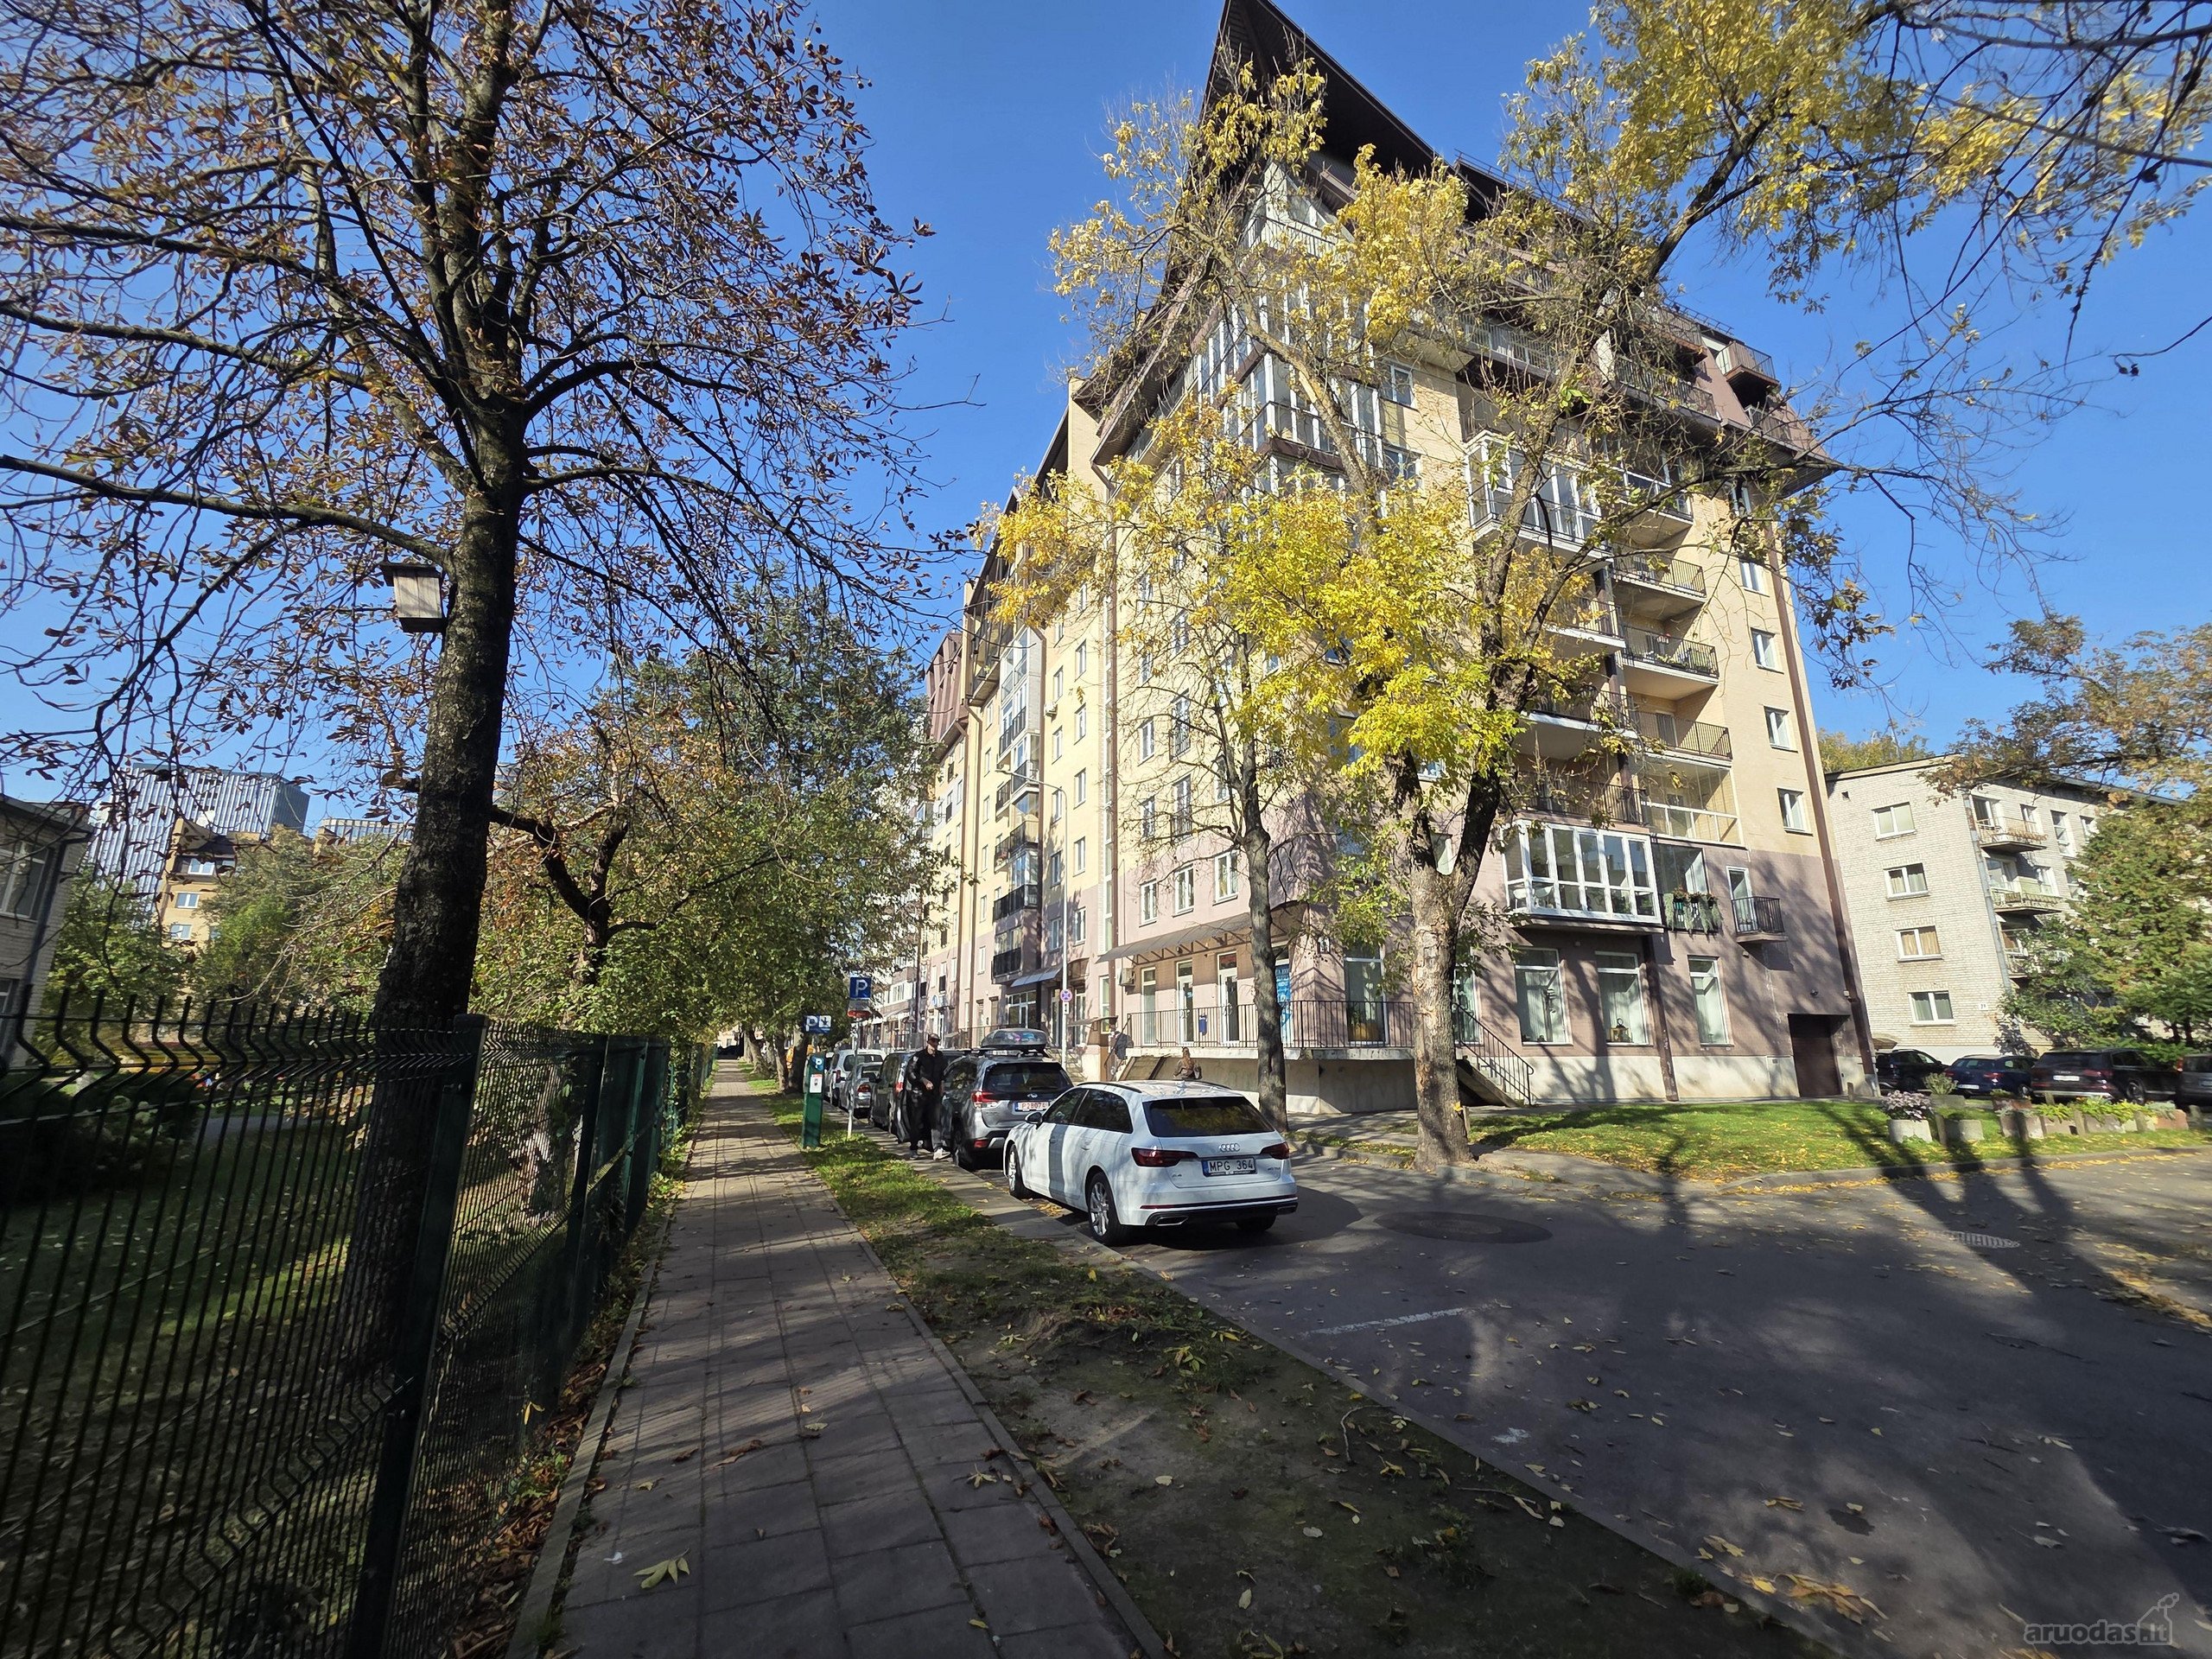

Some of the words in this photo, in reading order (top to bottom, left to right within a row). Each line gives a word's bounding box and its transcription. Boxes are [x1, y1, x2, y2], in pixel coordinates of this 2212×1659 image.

[855, 979, 868, 997] P
[805, 1015, 818, 1032] P
[1210, 1160, 1231, 1172] MPG
[1236, 1160, 1254, 1171] 364
